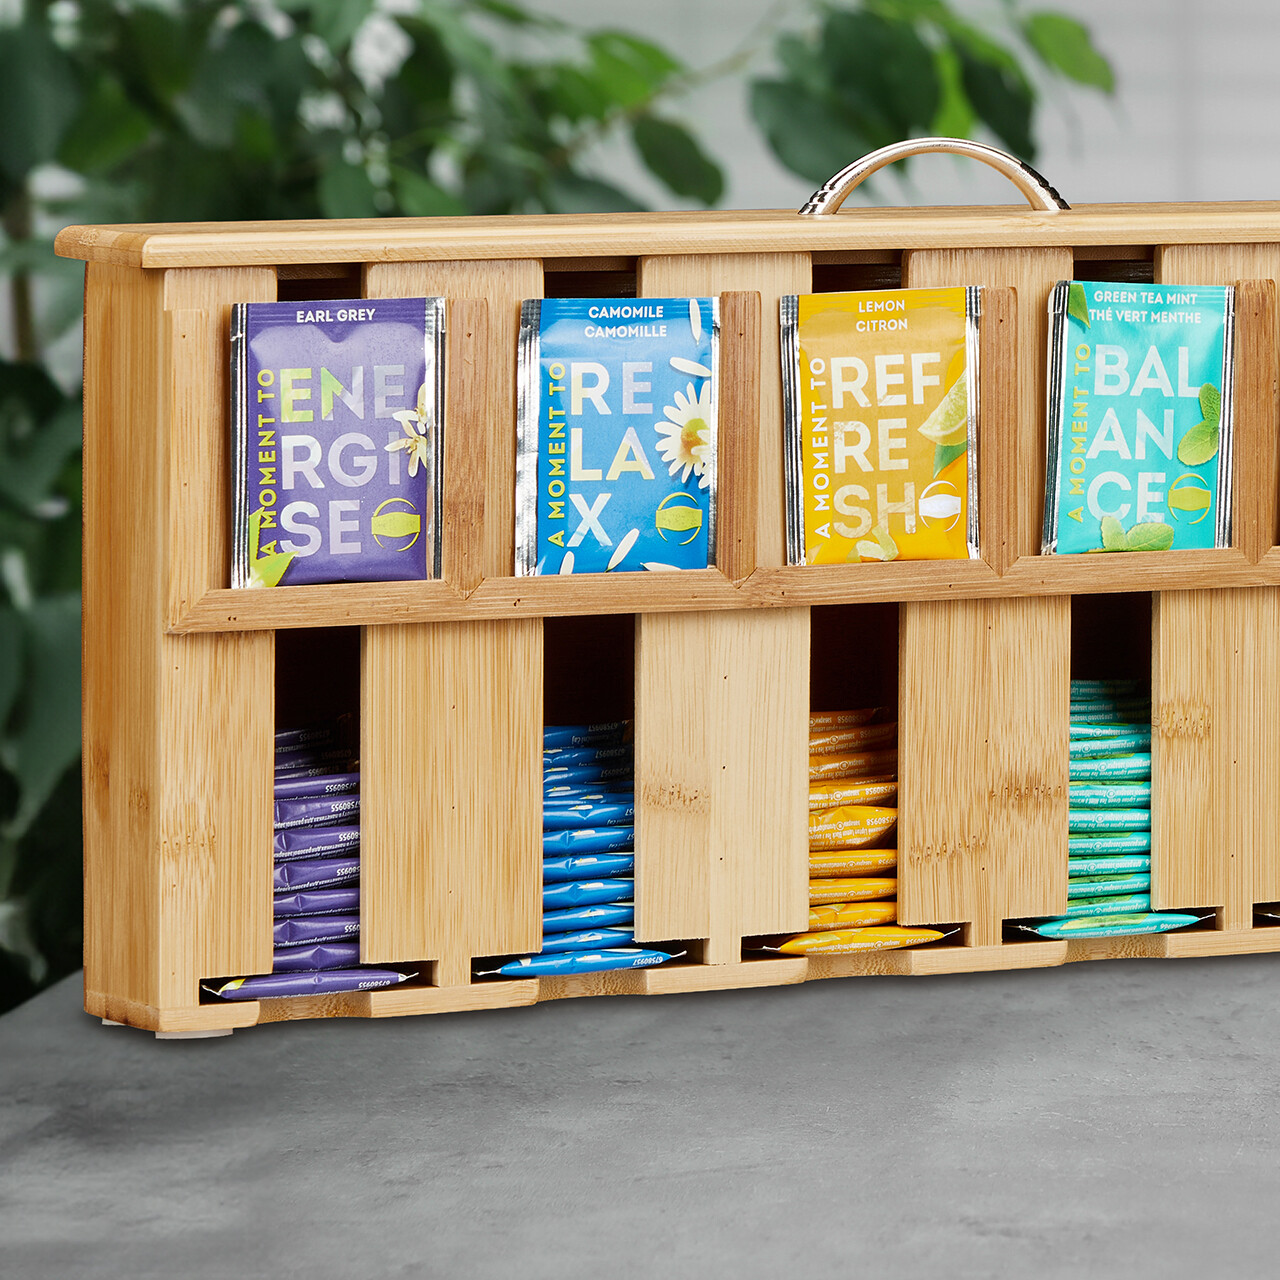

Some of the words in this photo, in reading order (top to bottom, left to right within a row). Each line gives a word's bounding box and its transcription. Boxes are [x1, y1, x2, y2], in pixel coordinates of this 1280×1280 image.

[588, 305, 664, 319] CAMOMILE
[858, 299, 905, 313] LEMON
[1089, 306, 1113, 321] THÉ
[1116, 310, 1148, 323] VERT
[1151, 311, 1201, 324] MENTHE
[1094, 290, 1137, 304] GREEN
[1141, 292, 1163, 305] TEA
[1167, 293, 1197, 306] MINT
[296, 310, 334, 323] EARL
[336, 308, 376, 322] GREY
[584, 325, 667, 338] CAMOMILLE
[855, 318, 908, 332] CITRON
[810, 357, 826, 390] TO
[1074, 344, 1091, 376] TO
[1094, 344, 1201, 398] BAL
[257, 369, 275, 403] TO
[280, 364, 405, 423] ENE
[549, 363, 566, 396] TO
[570, 361, 653, 416] RE
[830, 351, 941, 409] REF
[833, 418, 909, 474] RE
[1070, 388, 1089, 495] MOMENT
[1085, 407, 1174, 461] AN
[281, 431, 401, 490] RGI
[548, 408, 566, 519] MOMENT
[570, 426, 655, 481] LA
[811, 402, 830, 512] MOMENT
[258, 414, 277, 528] MOMENT
[833, 482, 916, 539] SH
[1086, 471, 1166, 523] CE
[279, 499, 362, 557] SE
[566, 493, 613, 547] X
[814, 522, 831, 539] A
[1067, 506, 1083, 523] A
[260, 540, 277, 559] A
[548, 530, 565, 547] A
[865, 785, 896, 795] 67580958
[338, 831, 360, 842] 80955
